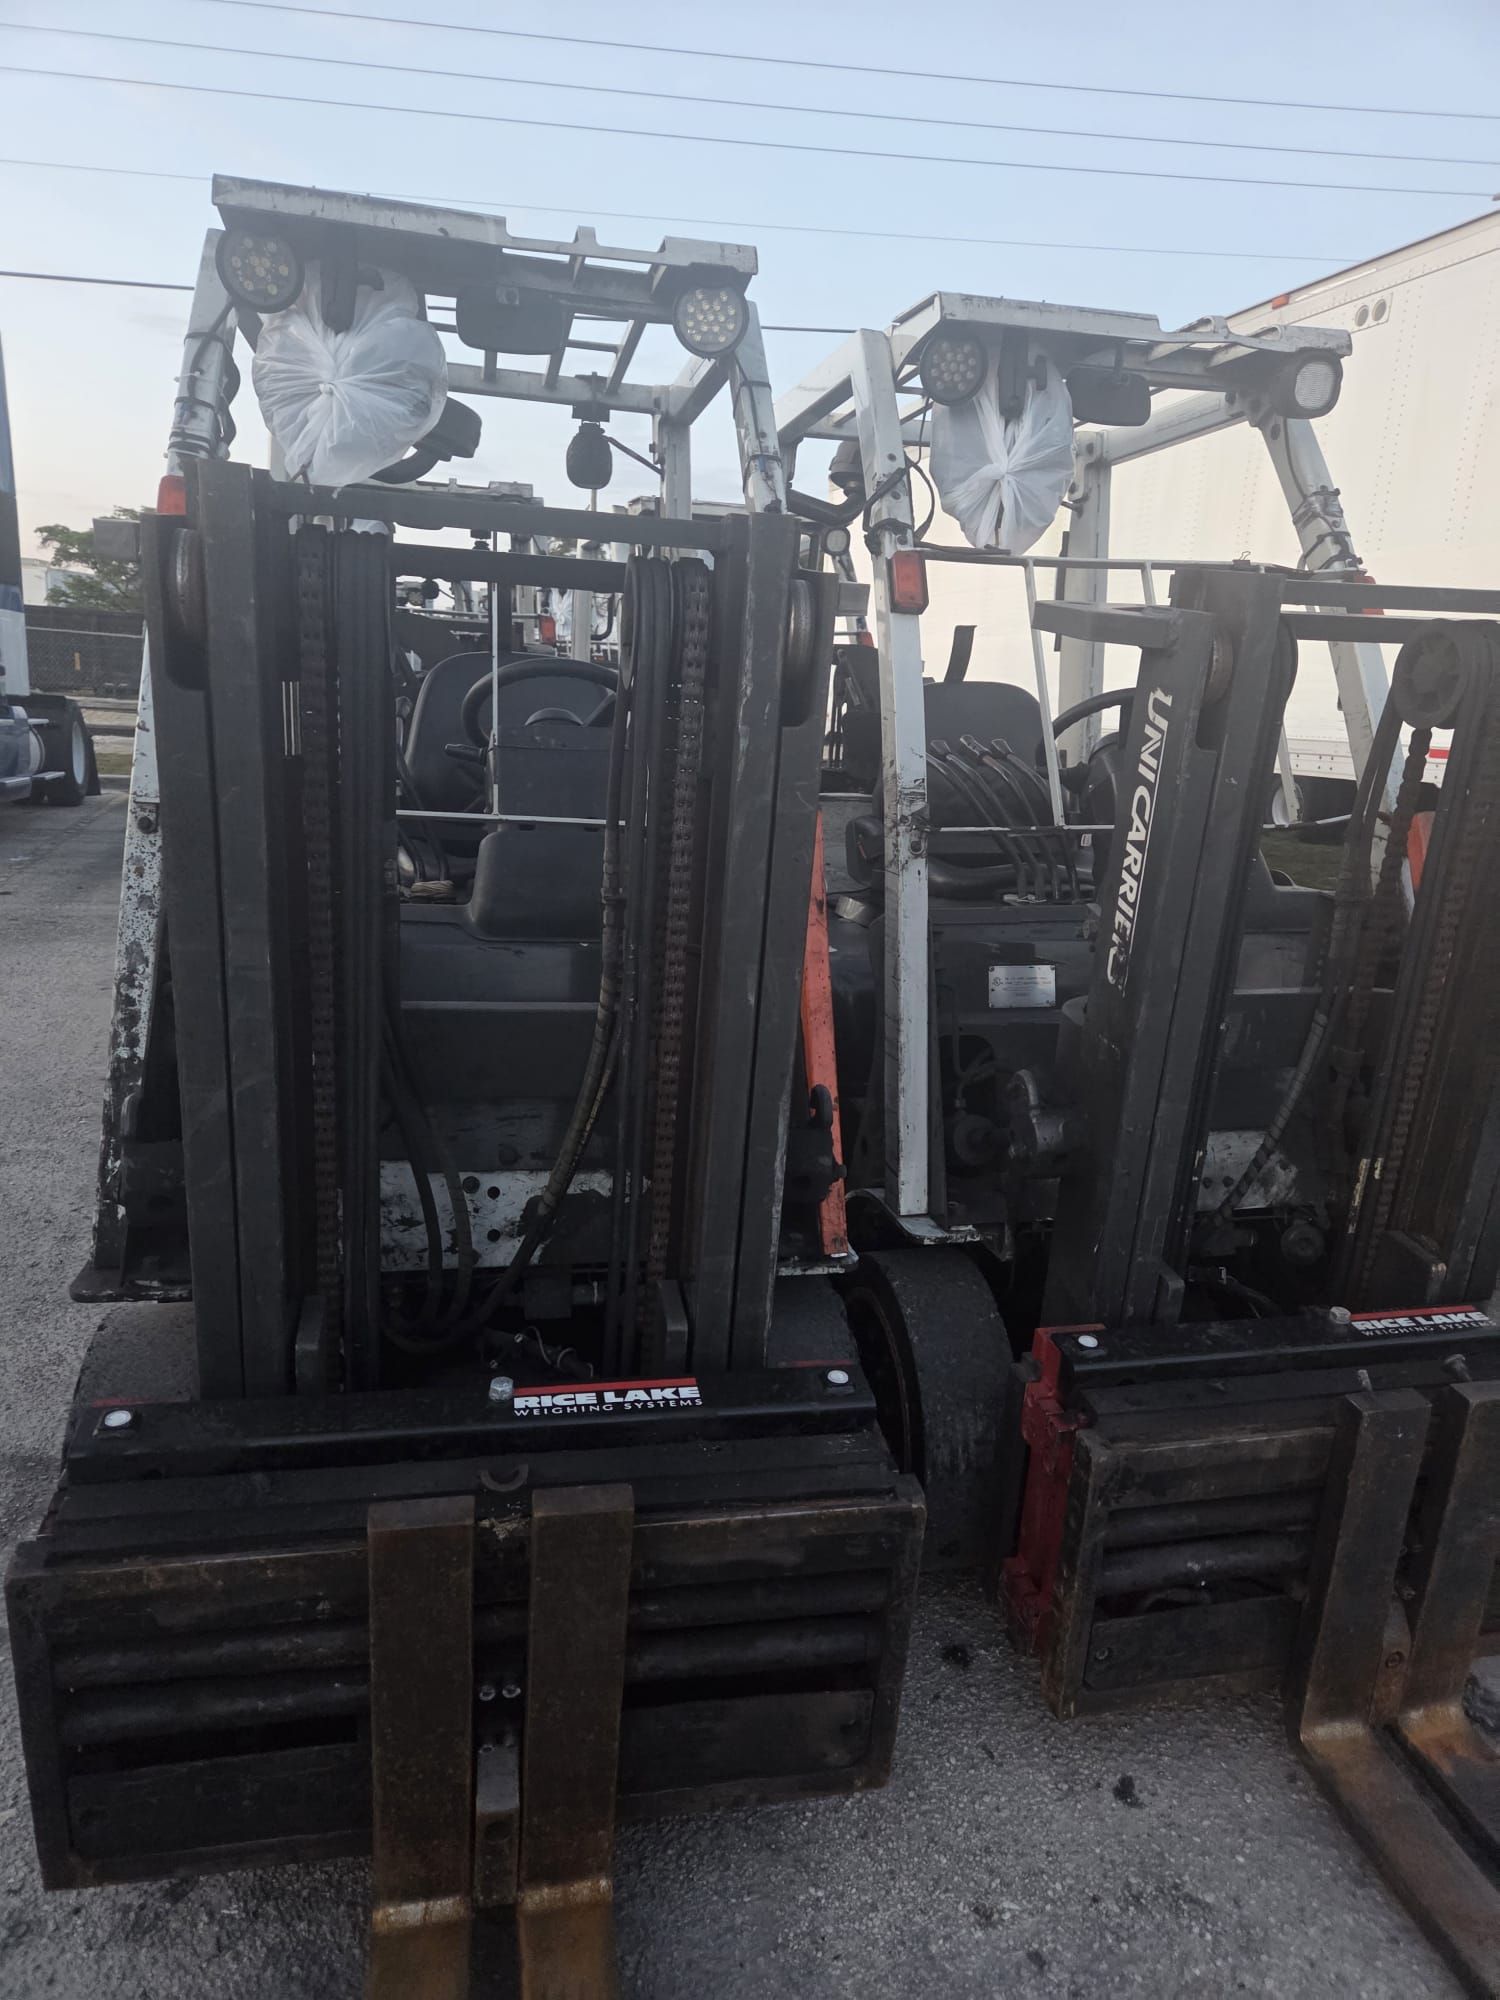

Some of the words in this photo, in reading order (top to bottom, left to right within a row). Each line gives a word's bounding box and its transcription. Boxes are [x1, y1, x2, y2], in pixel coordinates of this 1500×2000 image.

[1351, 1316, 1416, 1331] RICE
[1415, 1311, 1489, 1326] LAKE
[1361, 1326, 1434, 1337] WEIGHING
[1437, 1320, 1497, 1332] SYSTEMS
[514, 1392, 597, 1408] RICE
[604, 1386, 701, 1403] LAKE
[514, 1404, 614, 1417] WEIGHING
[624, 1398, 703, 1410] SYSTEMS
